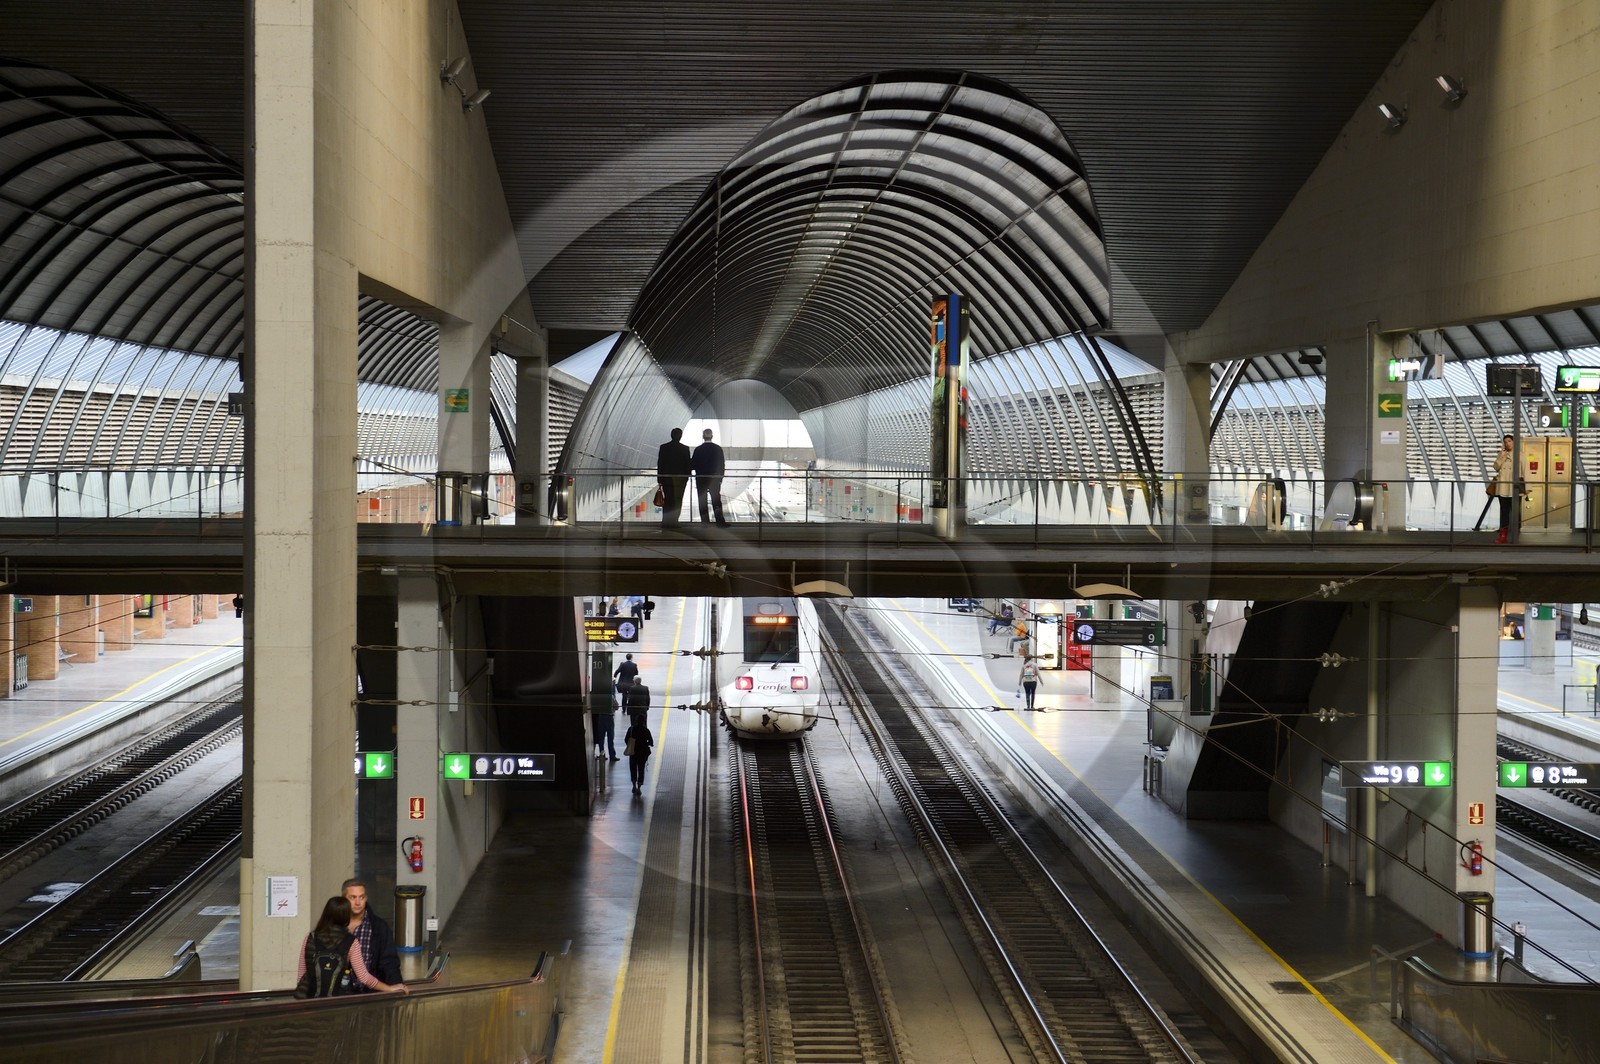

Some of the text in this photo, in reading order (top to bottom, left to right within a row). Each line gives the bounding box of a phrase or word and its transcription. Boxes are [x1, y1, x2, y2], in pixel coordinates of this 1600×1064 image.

[1564, 375, 1573, 386] 9
[231, 403, 244, 415] 11
[1541, 415, 1551, 427] 9
[1076, 611, 1082, 619] 9
[1135, 611, 1141, 619] 8
[1532, 607, 1538, 617] B
[1148, 633, 1156, 643] 9
[593, 660, 603, 670] 10
[757, 683, 788, 691] renfe
[492, 758, 515, 775] 10
[1390, 766, 1403, 783] 9
[1548, 766, 1560, 784] 8
